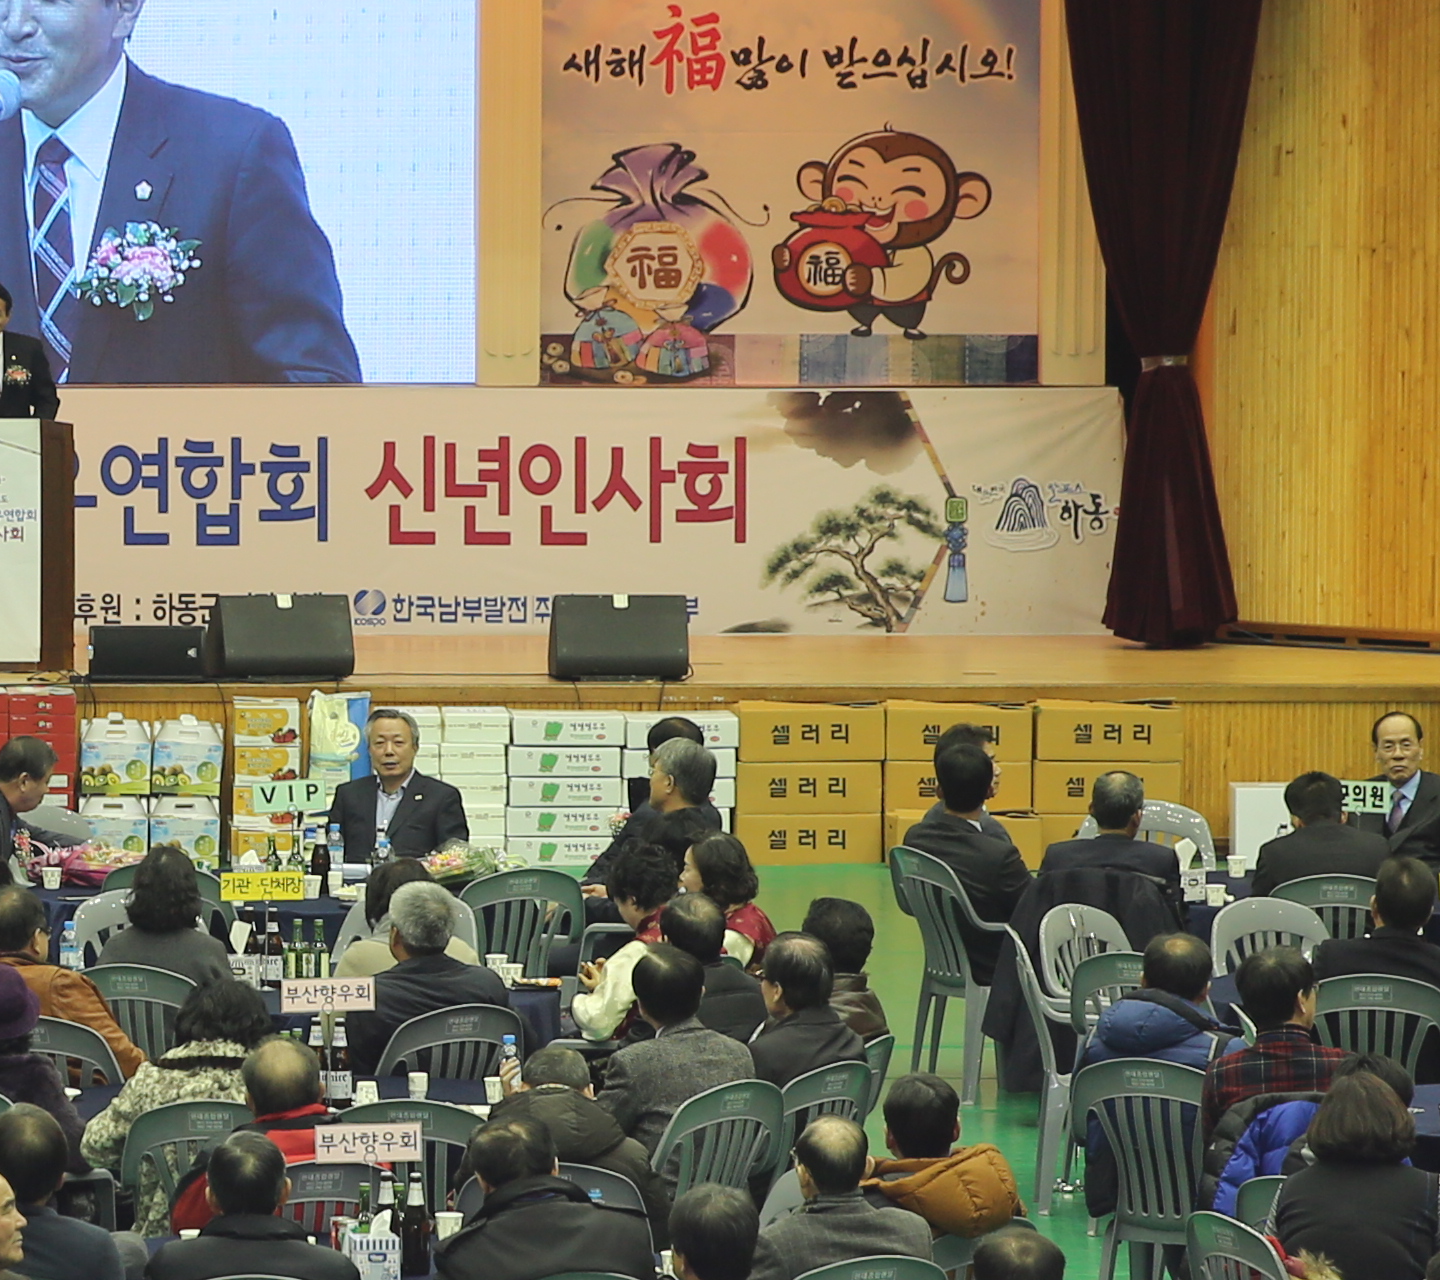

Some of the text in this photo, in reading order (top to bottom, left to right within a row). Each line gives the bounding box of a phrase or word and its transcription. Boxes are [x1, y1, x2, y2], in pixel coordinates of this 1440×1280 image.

[821, 37, 1017, 90] 받으십시오!
[364, 435, 748, 546] 신년인사회
[74, 593, 122, 624] 후원
[221, 876, 254, 897] 기관
[283, 981, 372, 1007] 부산향우회
[318, 1129, 419, 1155] 부산향우회
